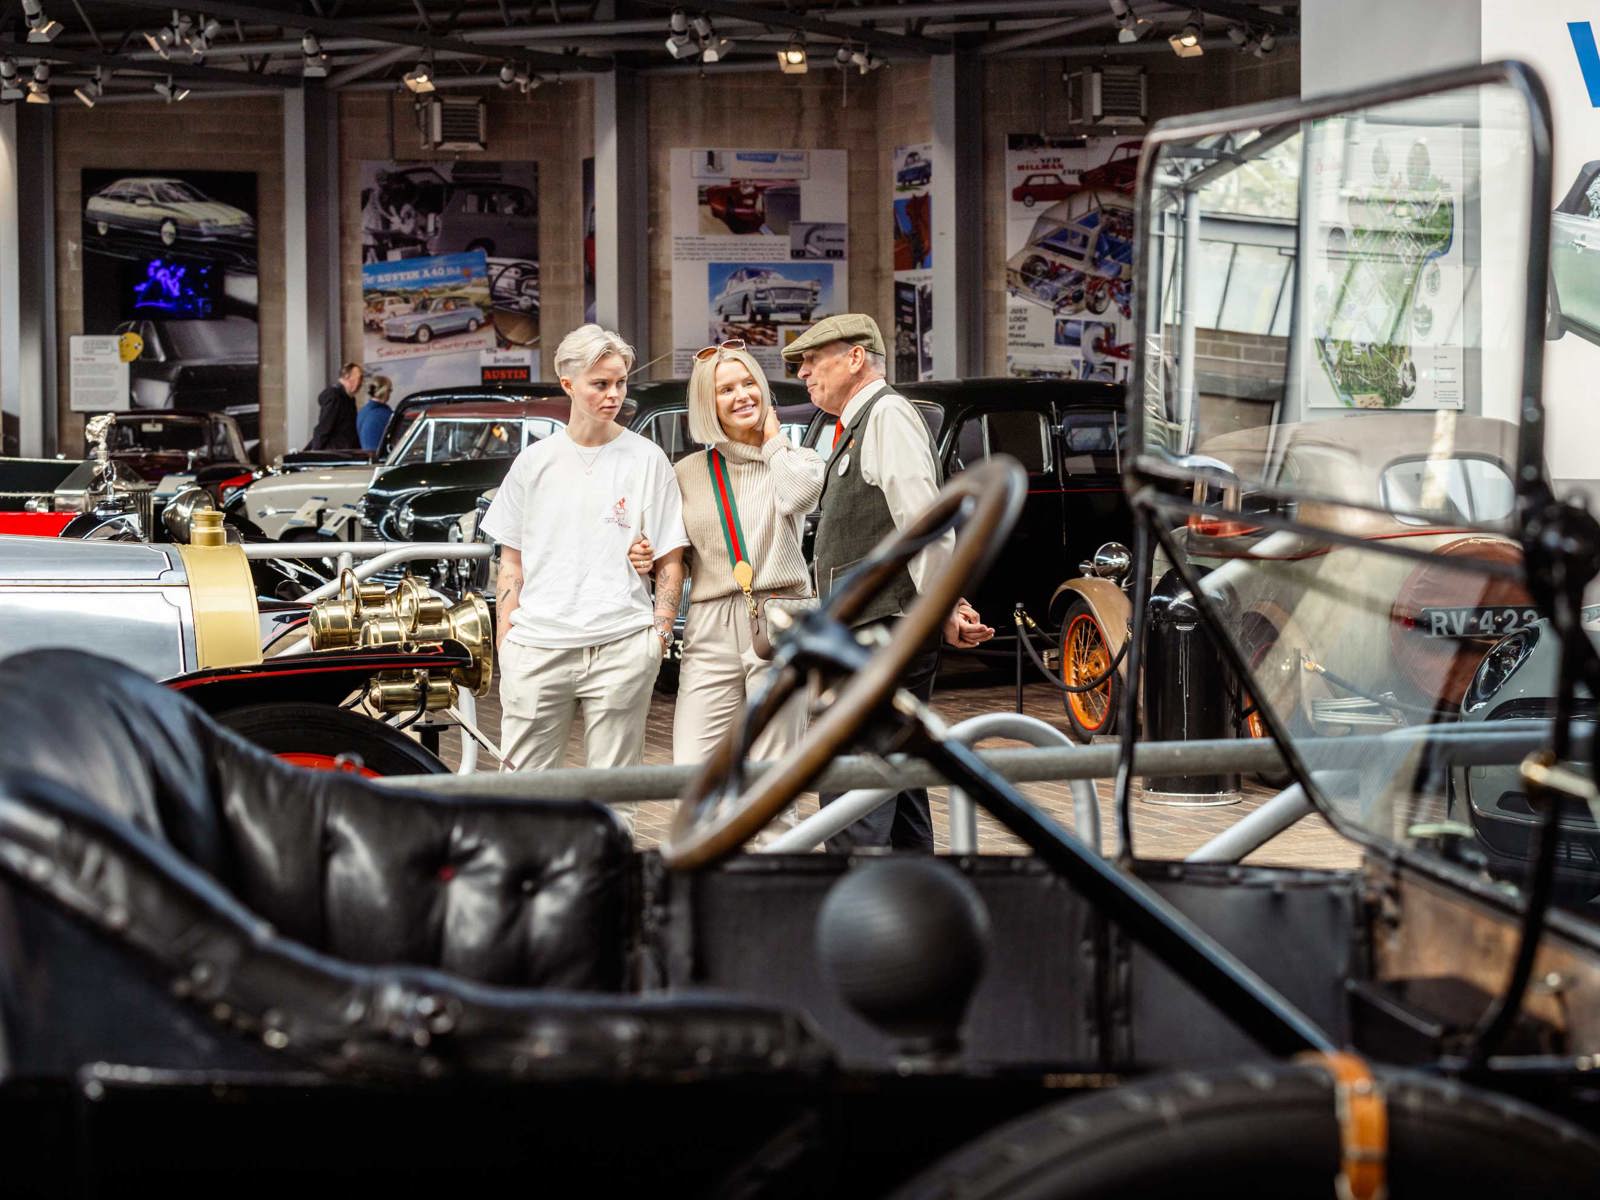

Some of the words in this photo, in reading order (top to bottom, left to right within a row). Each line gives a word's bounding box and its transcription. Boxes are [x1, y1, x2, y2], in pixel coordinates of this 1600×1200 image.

[377, 271, 420, 284] AUSTIN
[483, 369, 527, 380] AUSTIN
[1431, 611, 1467, 636] RV
